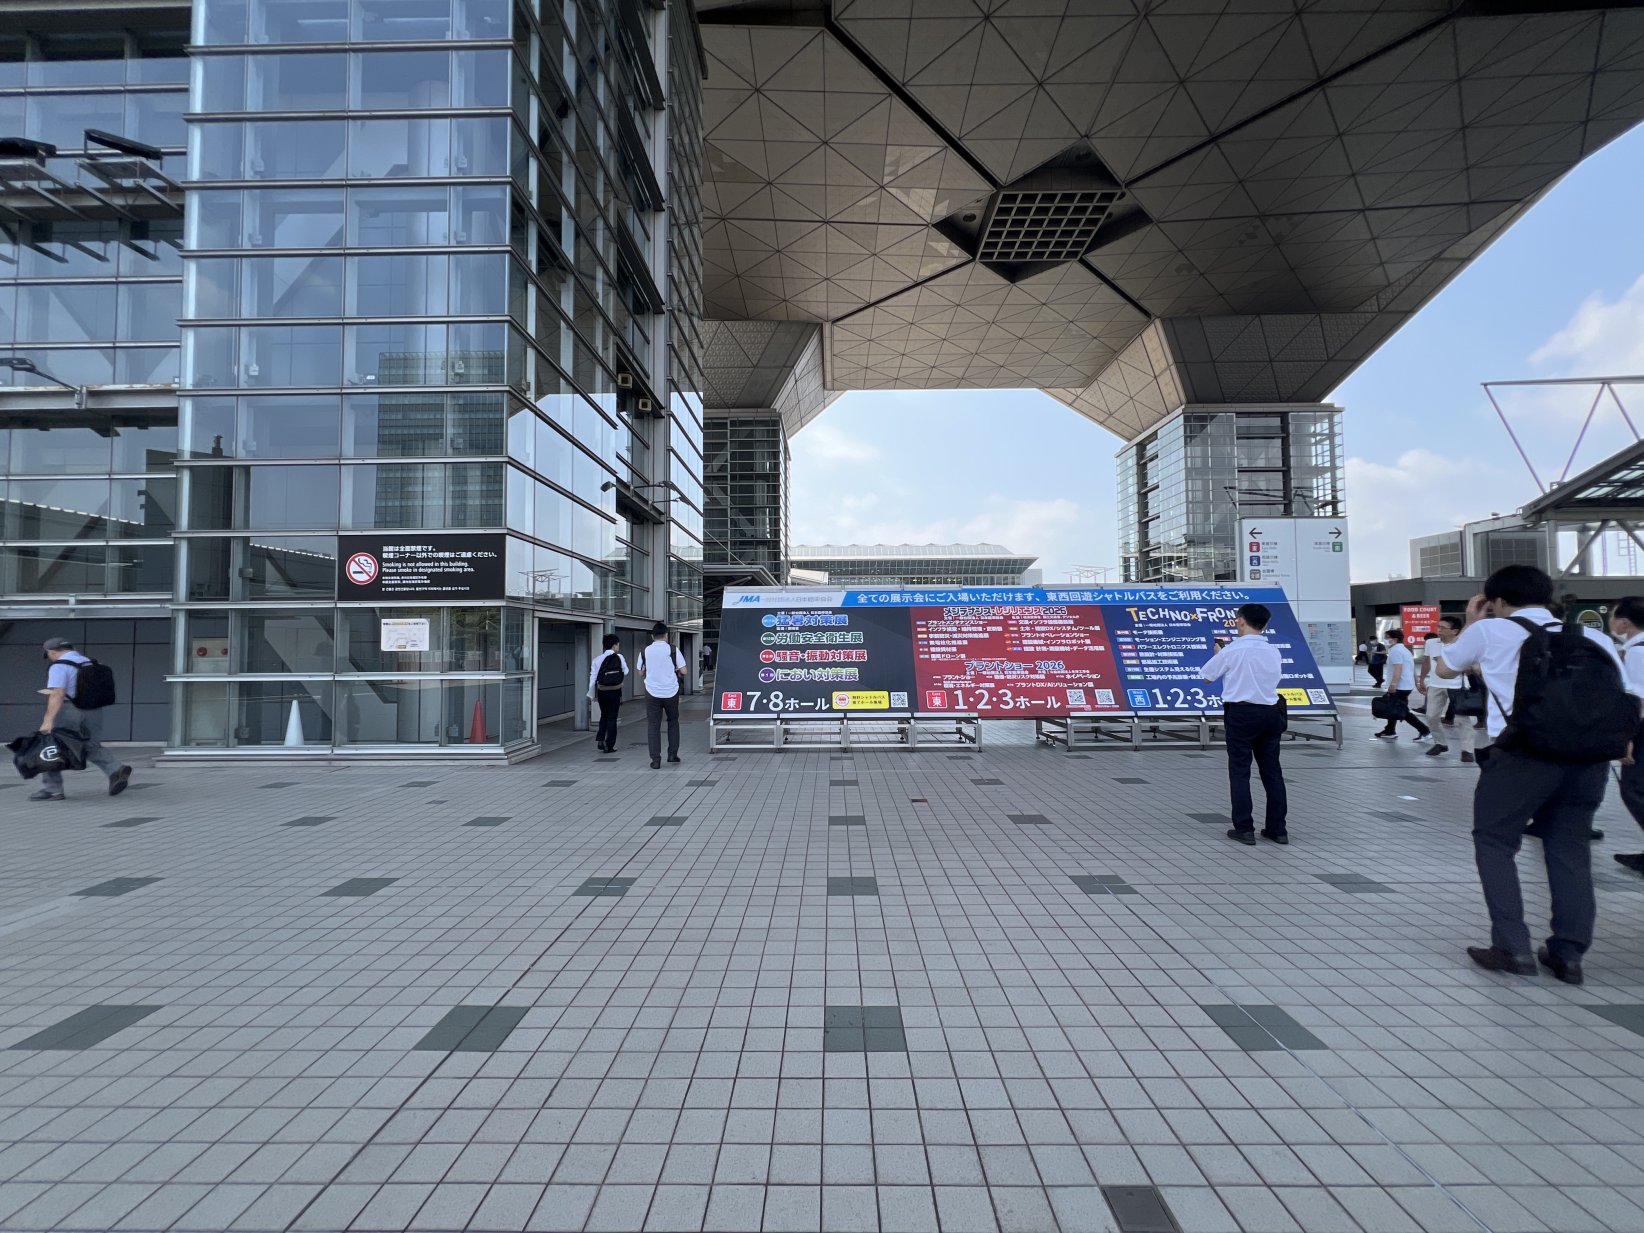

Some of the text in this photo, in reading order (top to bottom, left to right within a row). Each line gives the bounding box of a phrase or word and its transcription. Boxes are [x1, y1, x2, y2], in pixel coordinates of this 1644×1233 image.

[734, 596, 760, 604] JMA
[857, 590, 1250, 604] 全ての展示会にご入場いただけます、東西回遊シャトルバスをご利用ください。
[776, 614, 848, 626] 猛暑対策展
[1222, 620, 1238, 628] 20
[776, 632, 863, 644] 労働安全衛生展
[775, 650, 867, 662] 騒音・振動対策展
[964, 660, 1065, 672] プラントショー 2026
[776, 668, 859, 682] におい対策展
[727, 698, 736, 708] 東
[932, 696, 942, 707] 東
[954, 689, 1061, 710] 1・2・3ホール
[1134, 696, 1144, 705] 西
[1152, 688, 1224, 708] 1・2・3ホ
